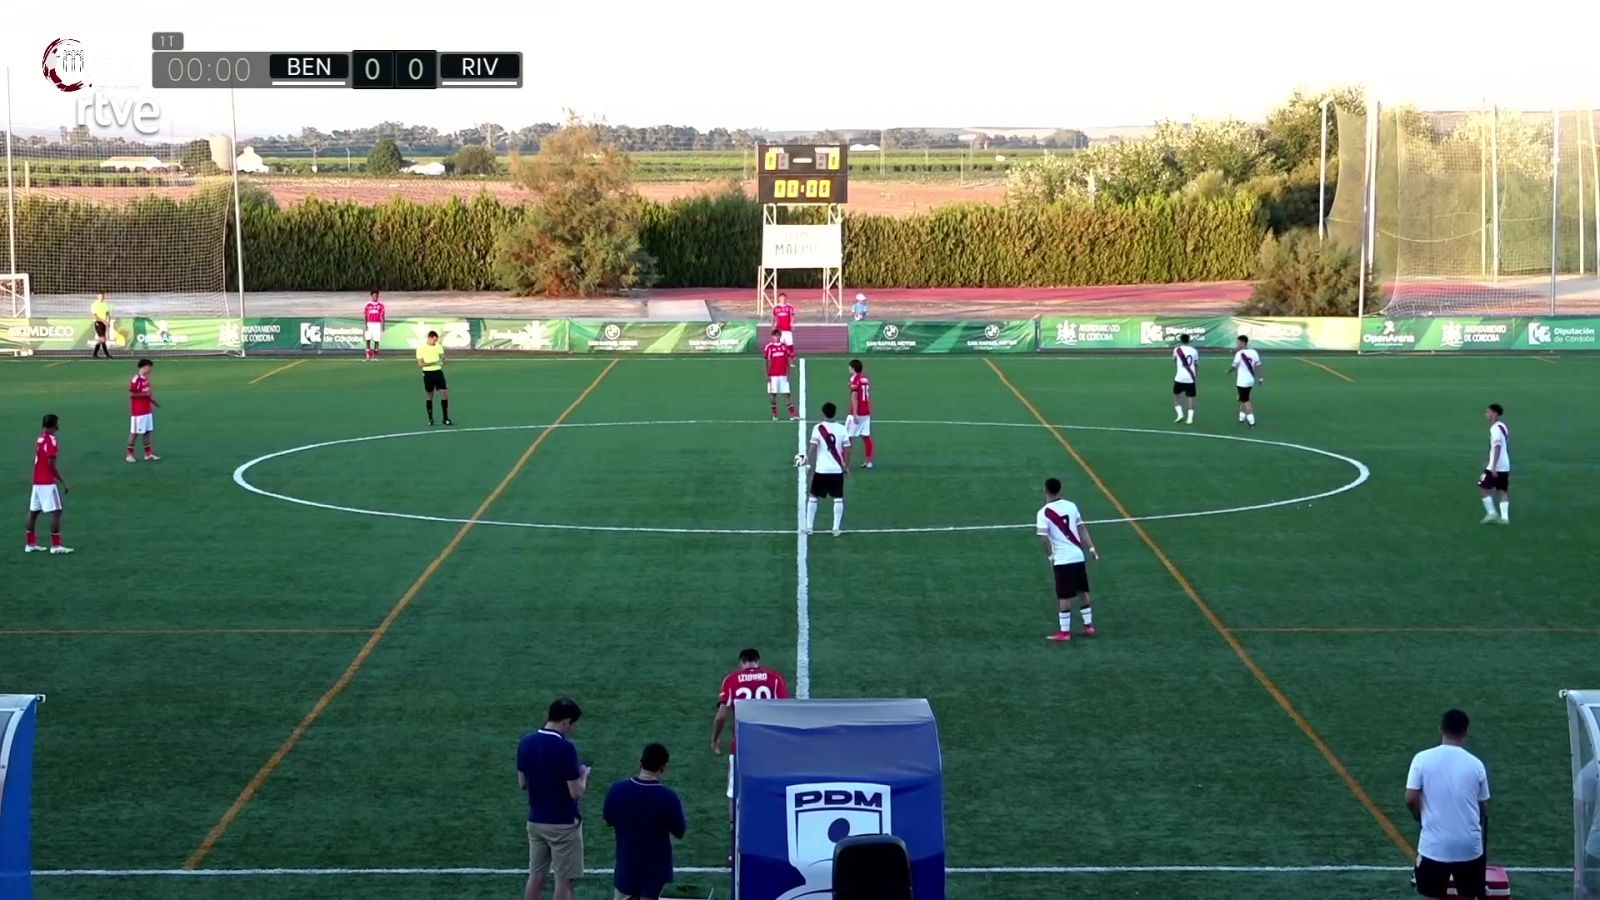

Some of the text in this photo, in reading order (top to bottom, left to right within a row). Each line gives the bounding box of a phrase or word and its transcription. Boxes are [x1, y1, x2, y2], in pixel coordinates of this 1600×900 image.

[1553, 327, 1595, 336] Diputación
[1362, 333, 1415, 344] OpenArena
[1553, 335, 1595, 343] de Córdoba
[794, 789, 883, 809] PDM
